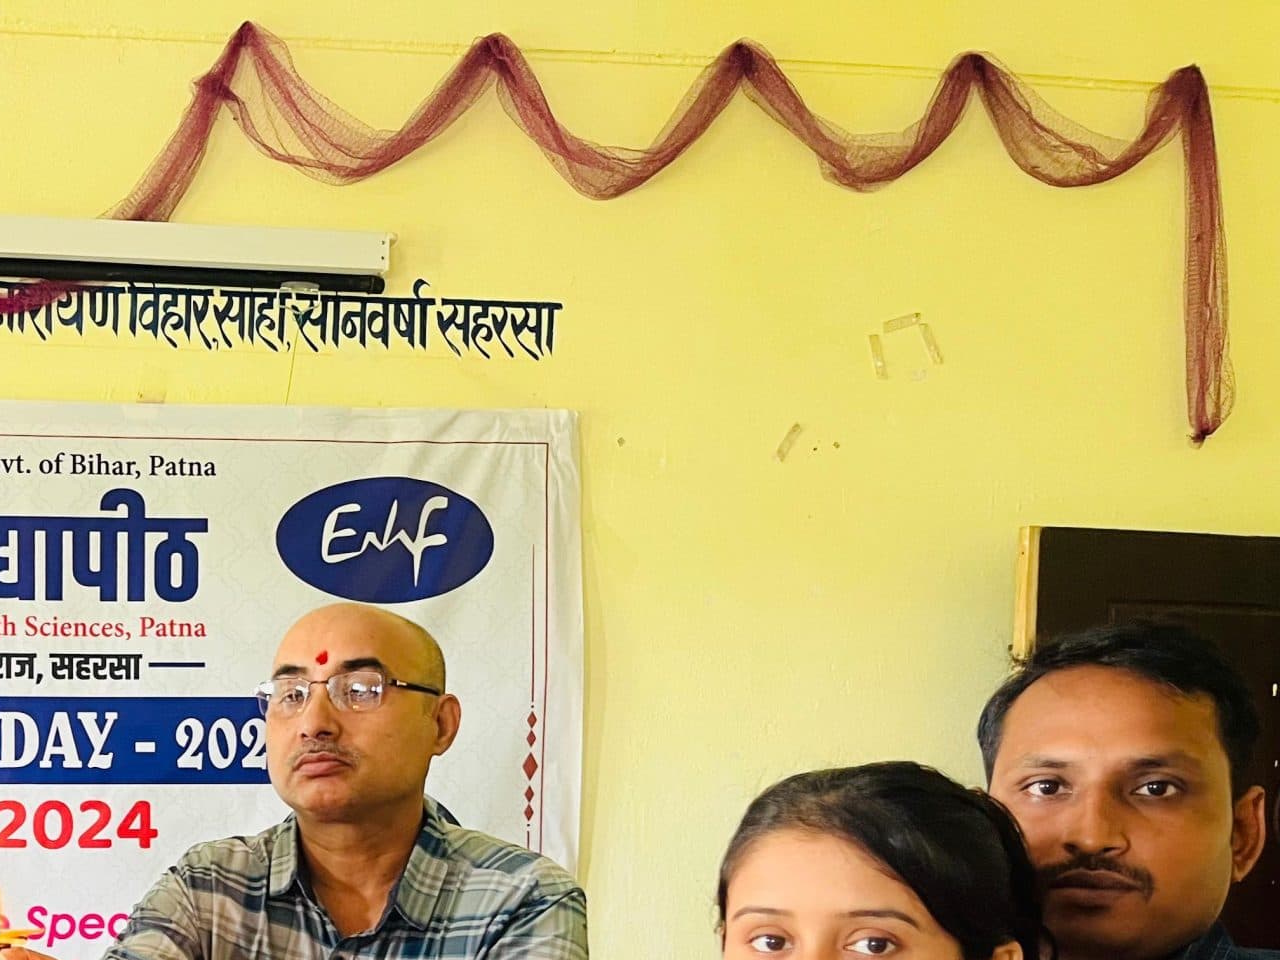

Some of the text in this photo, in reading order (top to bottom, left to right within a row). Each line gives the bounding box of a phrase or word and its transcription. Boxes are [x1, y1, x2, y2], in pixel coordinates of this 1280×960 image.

[436, 297, 563, 360] सहरसा
[39, 452, 66, 475] of
[70, 453, 141, 479] Bihar,
[149, 455, 217, 477] Patna
[24, 615, 132, 641] Sciences,
[139, 616, 208, 638] Patna
[49, 653, 143, 681] सहरसा
[175, 717, 267, 771] 202
